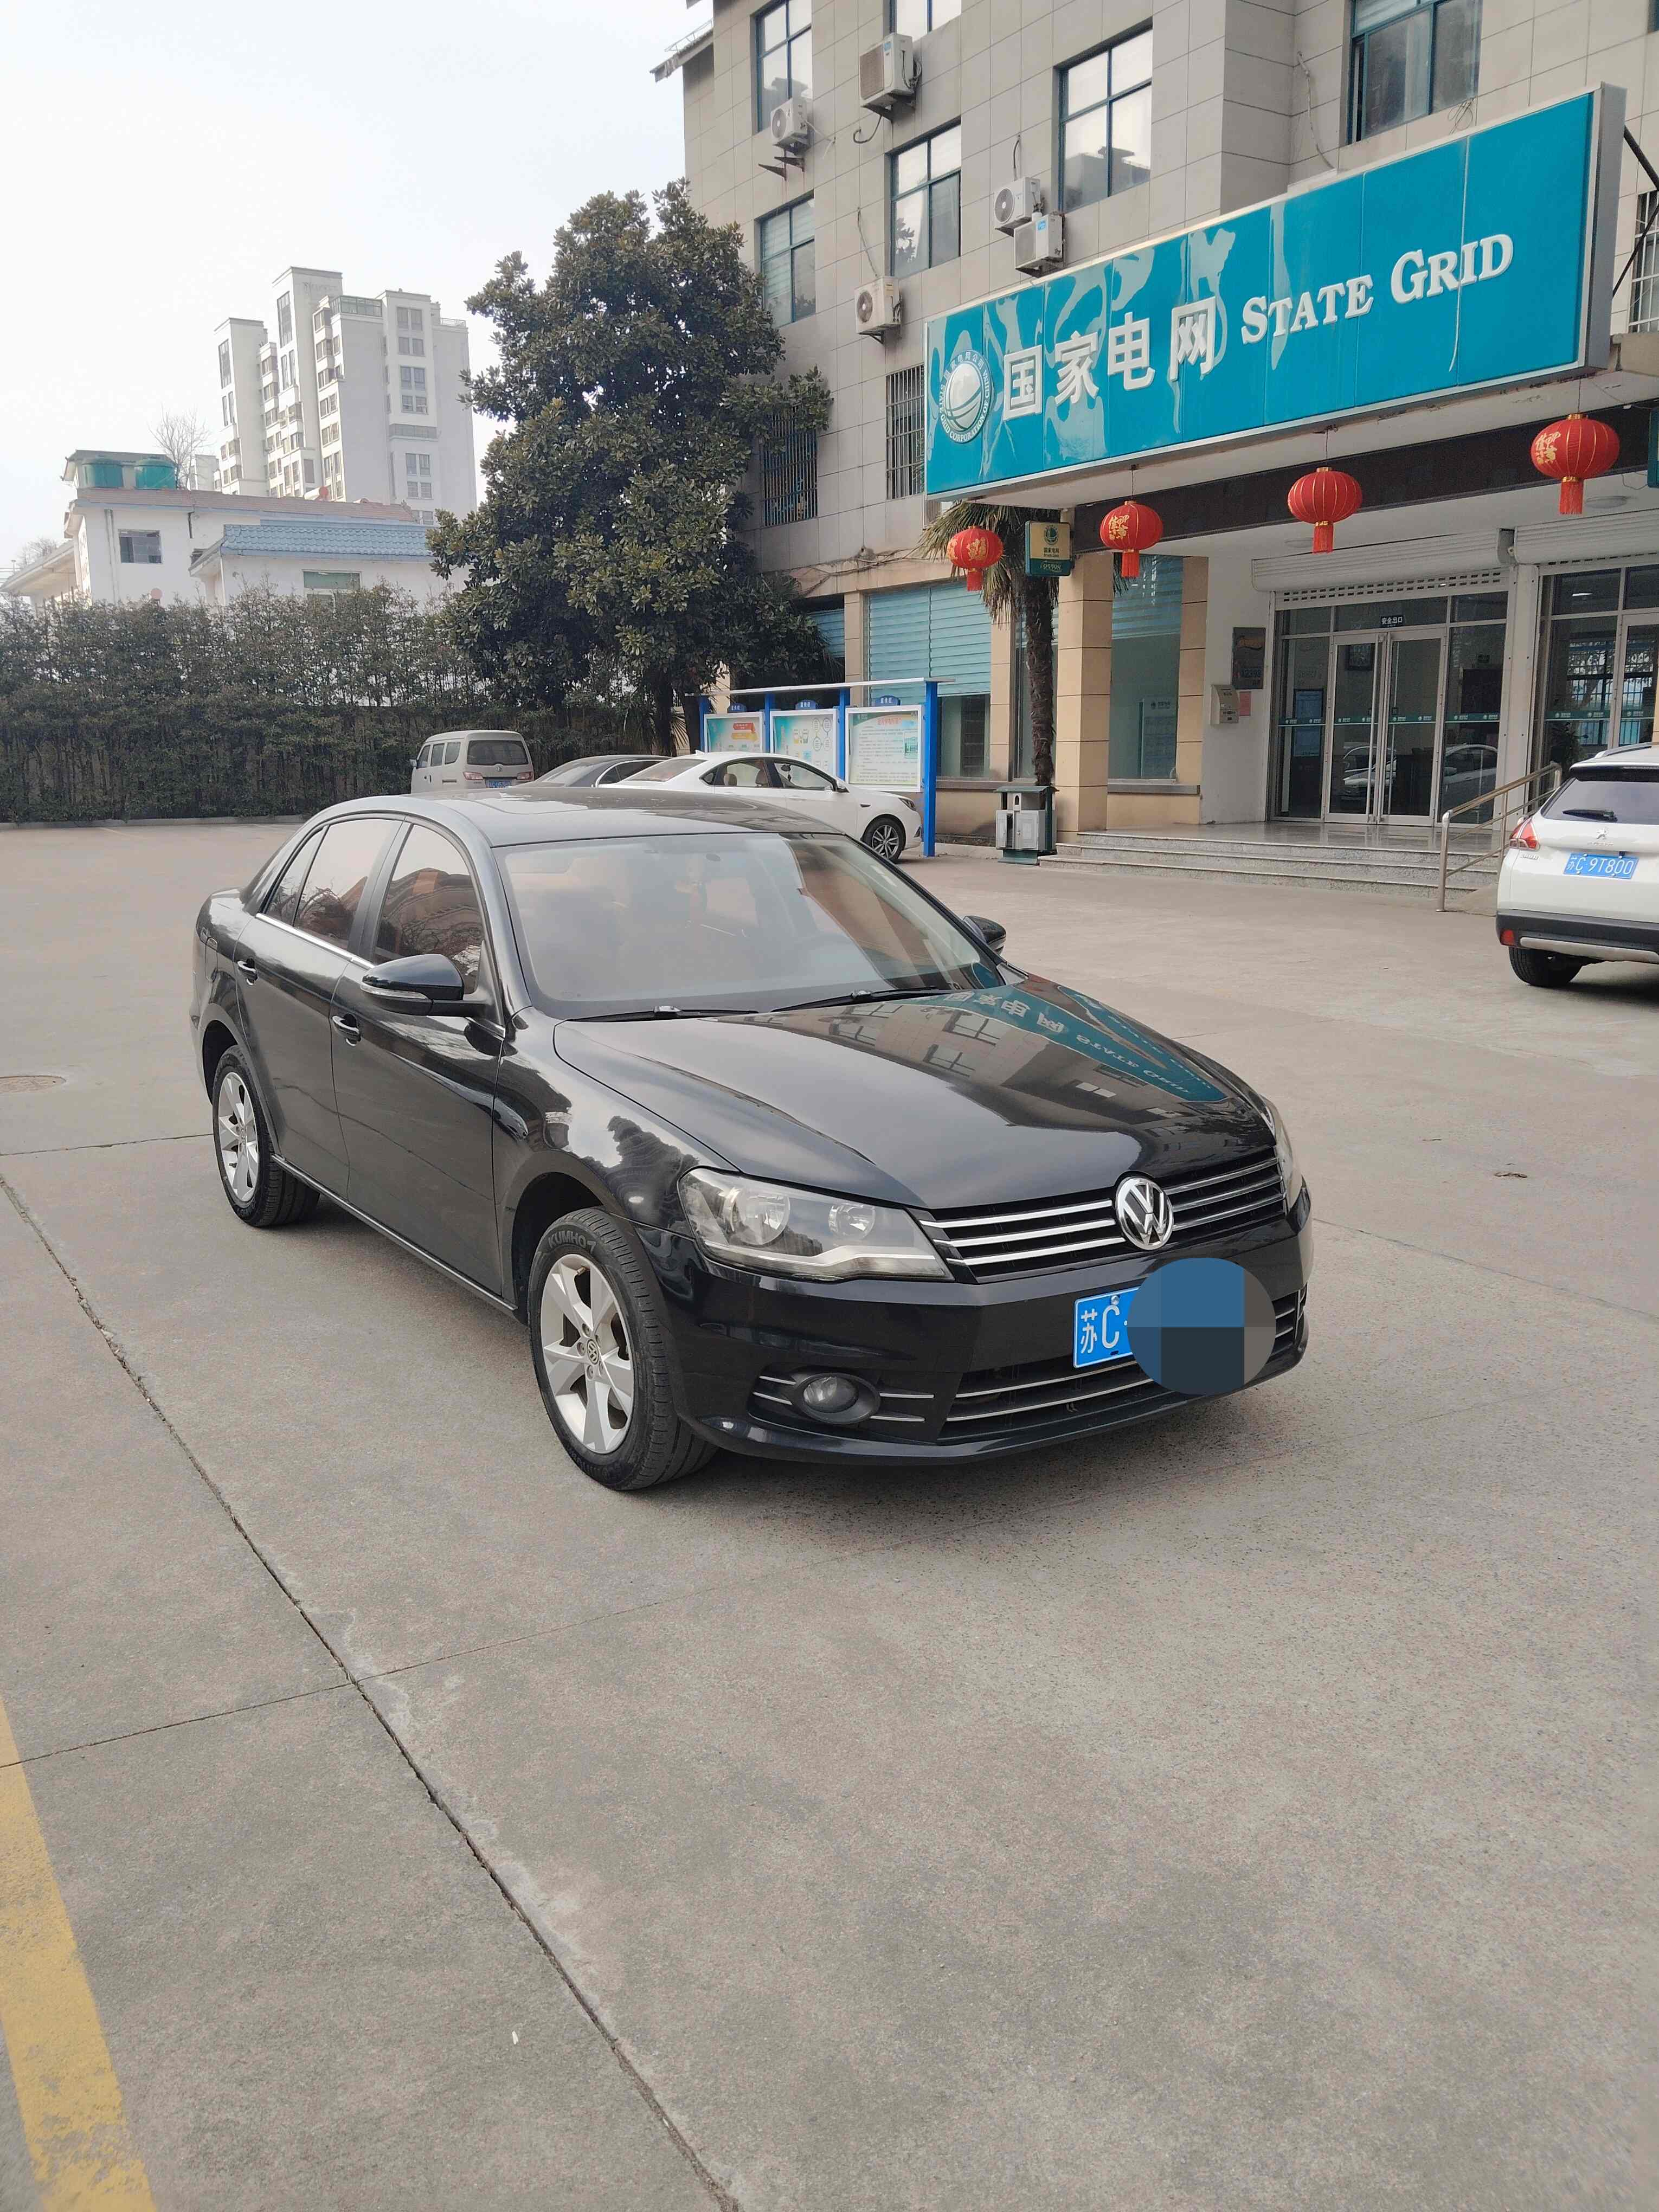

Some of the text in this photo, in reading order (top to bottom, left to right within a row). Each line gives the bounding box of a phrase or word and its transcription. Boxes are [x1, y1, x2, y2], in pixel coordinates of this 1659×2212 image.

[1003, 234, 1513, 421] 国家电网 STATE GRID
[949, 415, 986, 442] CORPORATION
[1381, 616, 1403, 625] 安全出口
[548, 1230, 587, 1249] KUMHO
